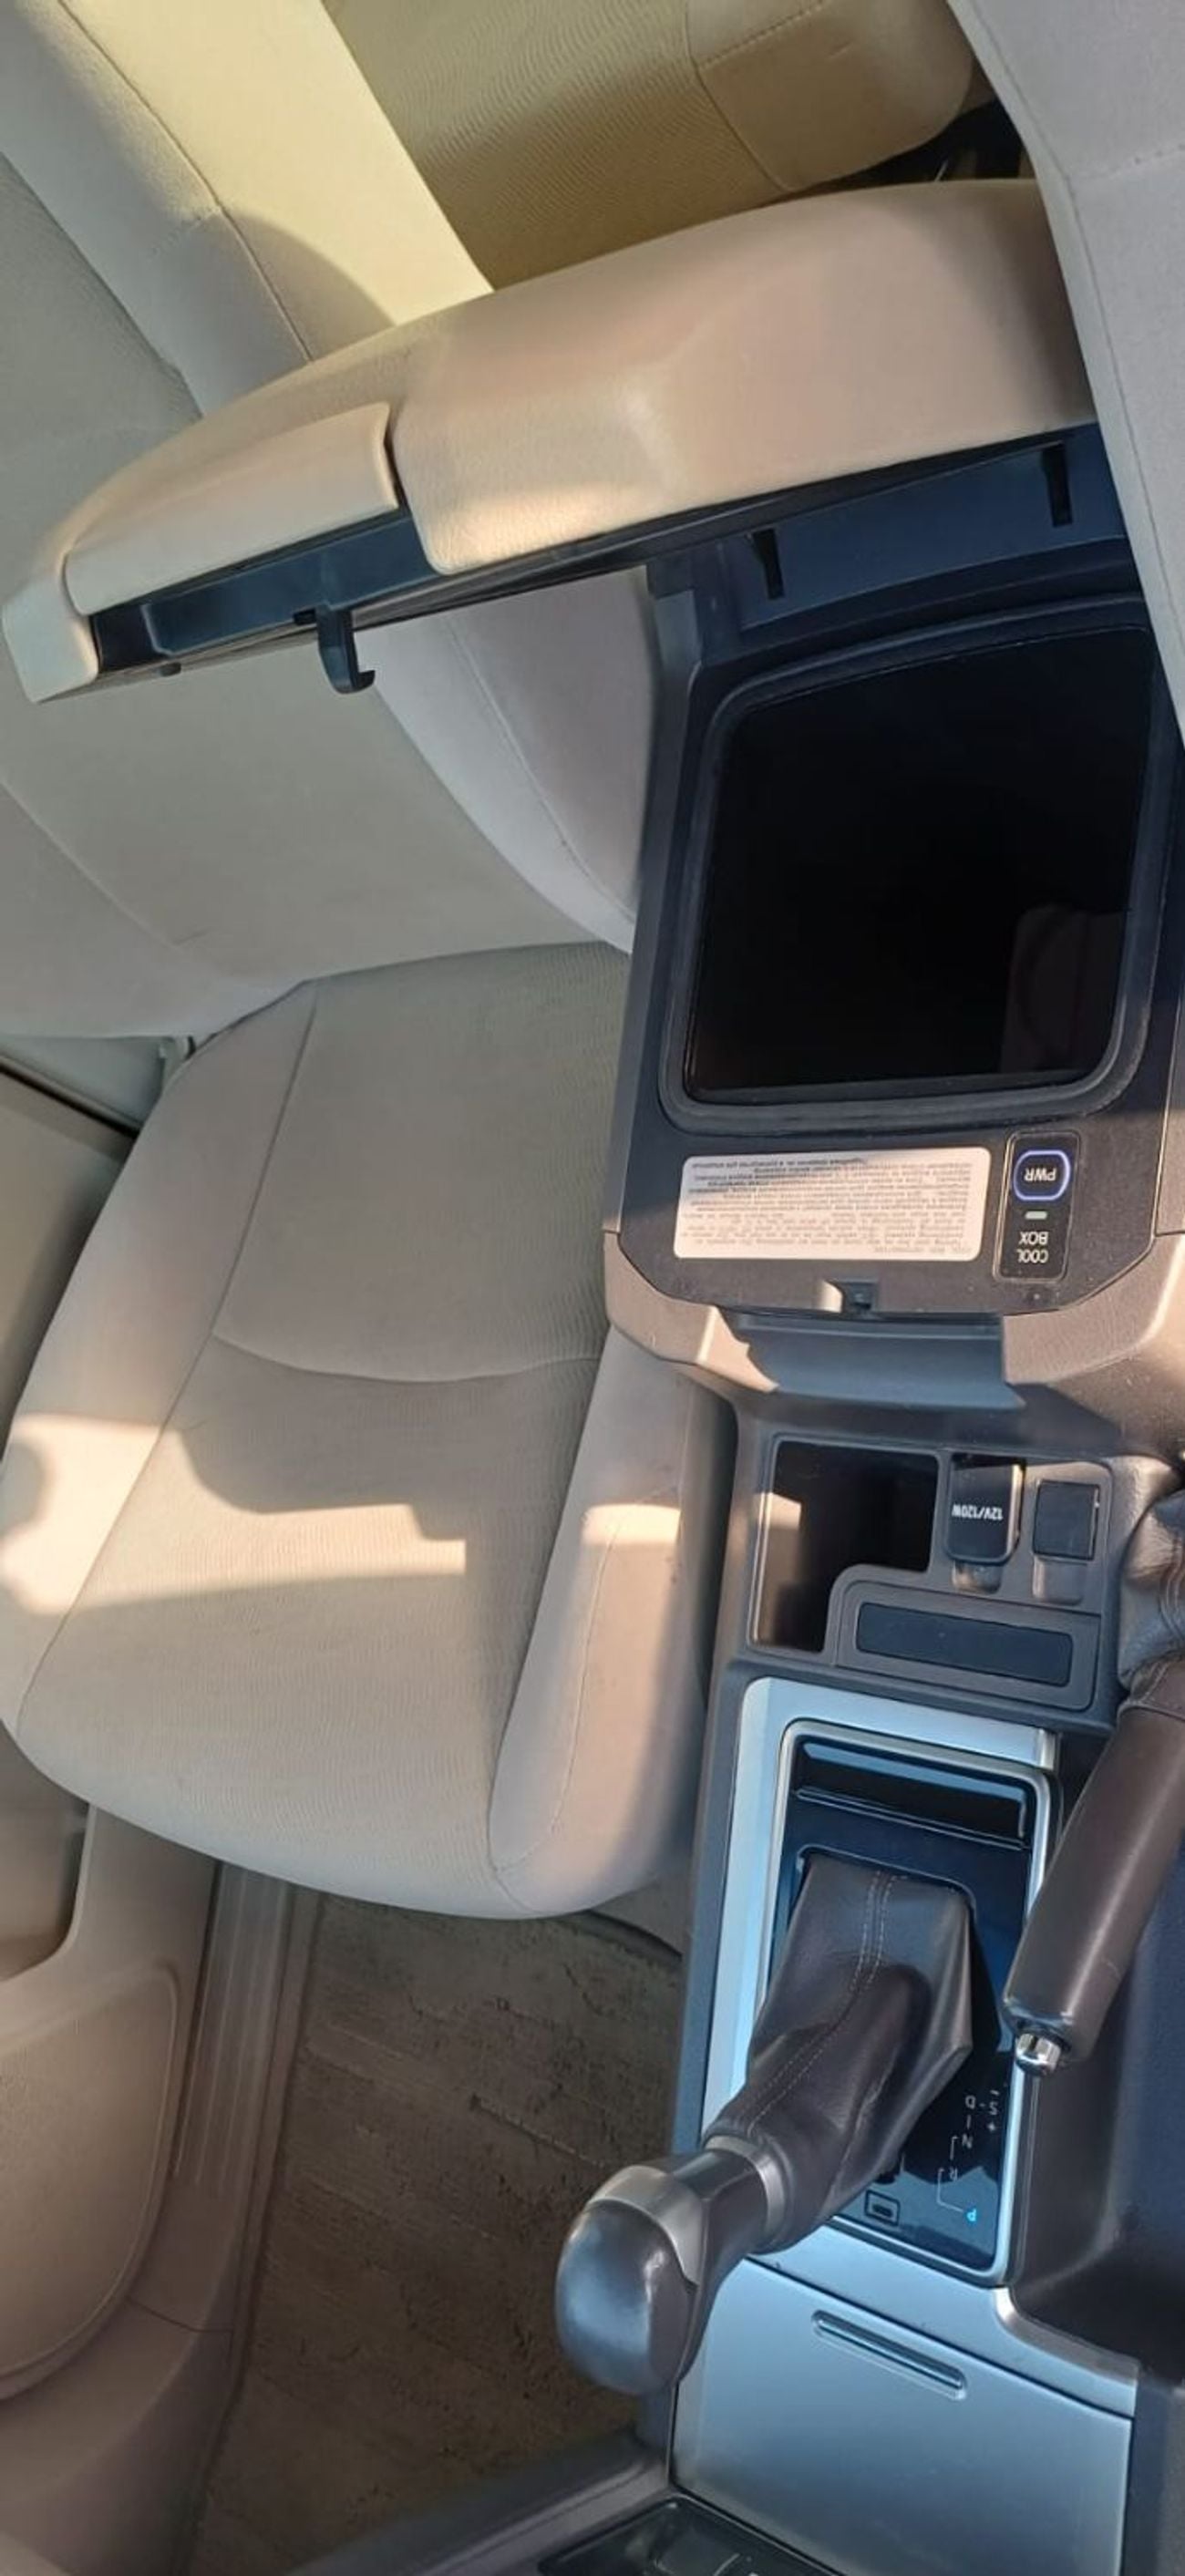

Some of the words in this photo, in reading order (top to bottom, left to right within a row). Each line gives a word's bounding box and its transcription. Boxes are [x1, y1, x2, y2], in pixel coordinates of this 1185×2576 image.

[1023, 1167, 1057, 1182] PWR
[1018, 1231, 1049, 1246] BOX
[1015, 1249, 1049, 1264] COOL
[951, 1503, 1004, 1521] 12V/120W
[965, 2096, 976, 2110] D
[989, 2101, 998, 2116] S
[962, 2133, 973, 2149] N
[949, 2167, 958, 2181] R
[966, 2208, 976, 2222] P
